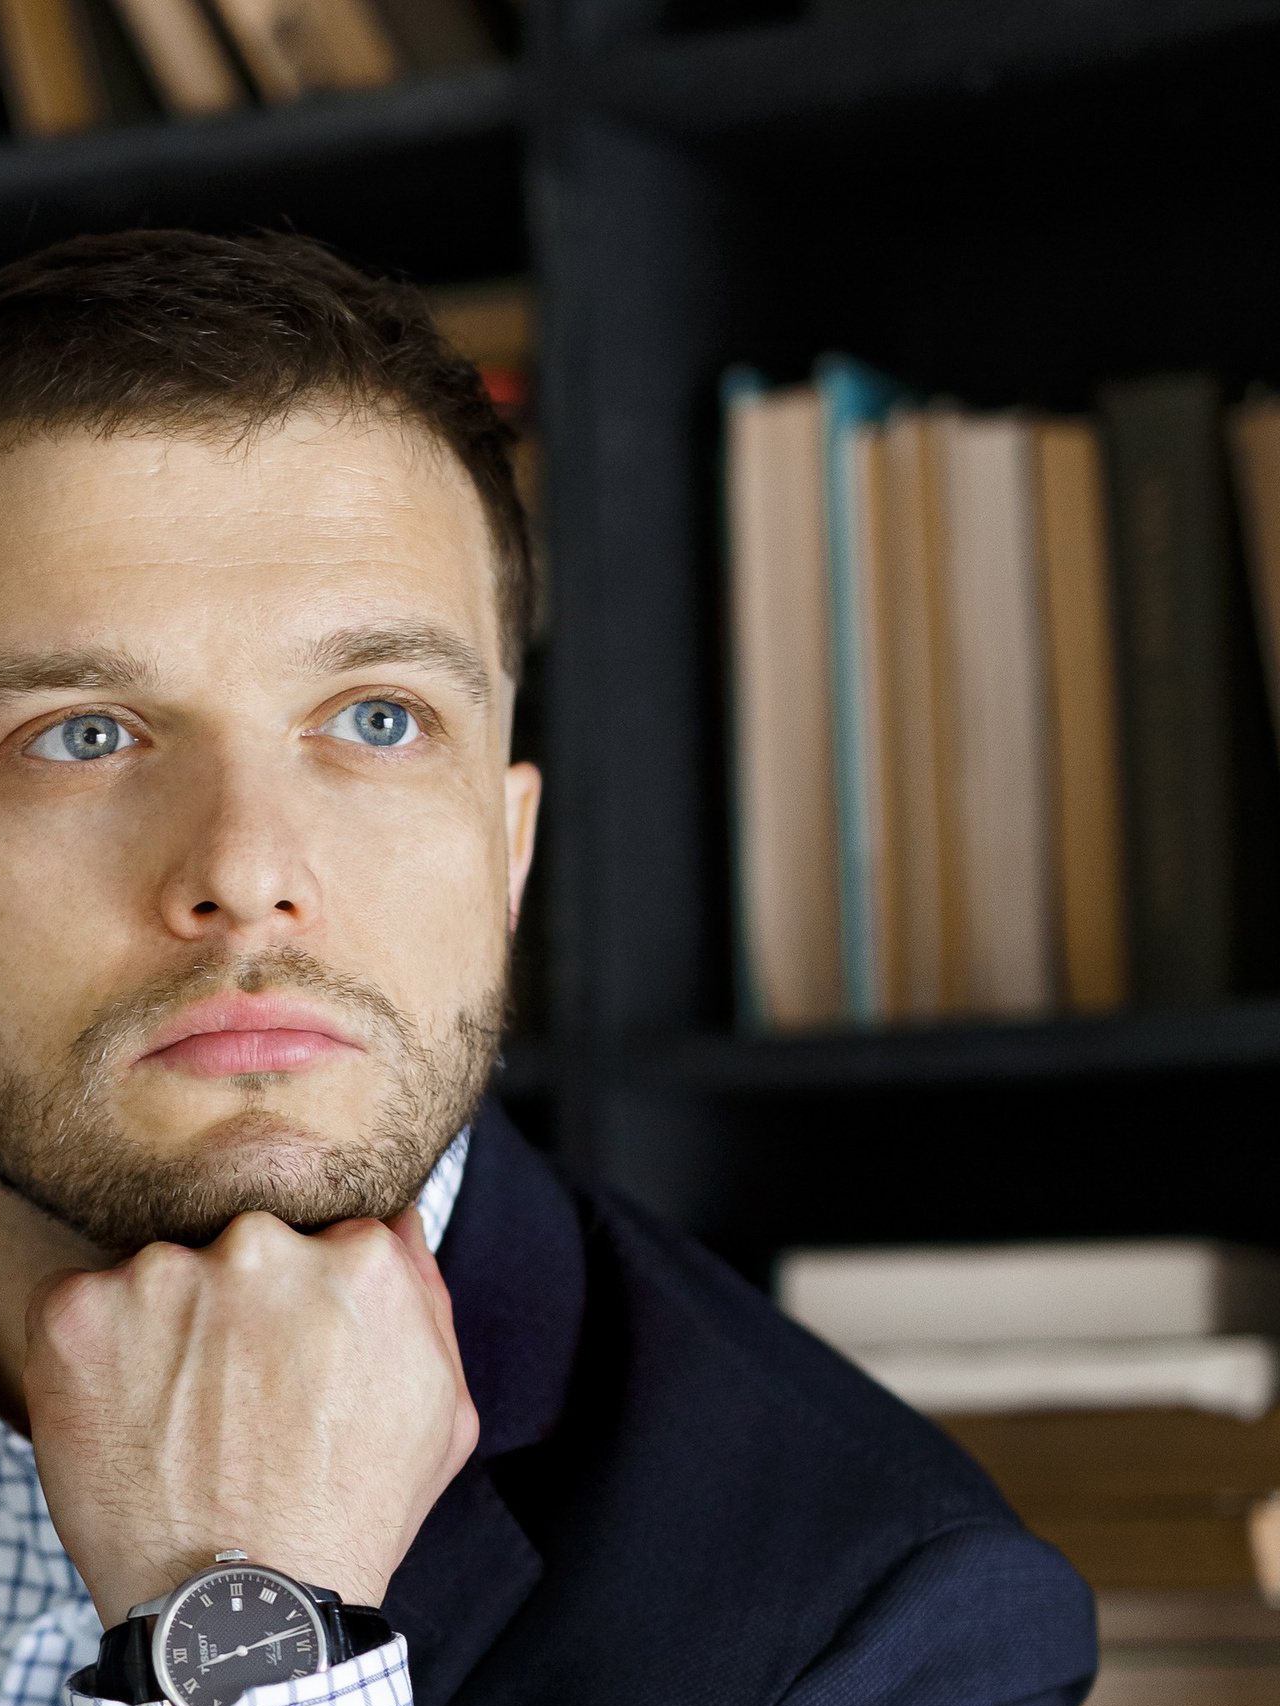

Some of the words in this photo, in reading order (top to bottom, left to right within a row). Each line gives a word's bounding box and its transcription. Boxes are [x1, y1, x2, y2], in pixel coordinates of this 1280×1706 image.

[230, 1583, 243, 1596] III
[200, 1593, 214, 1608] II
[286, 1609, 302, 1621] V
[296, 1639, 313, 1652] VI
[172, 1648, 189, 1664] XII
[198, 1633, 210, 1675] TSSOT
[182, 1678, 201, 1694] XI
